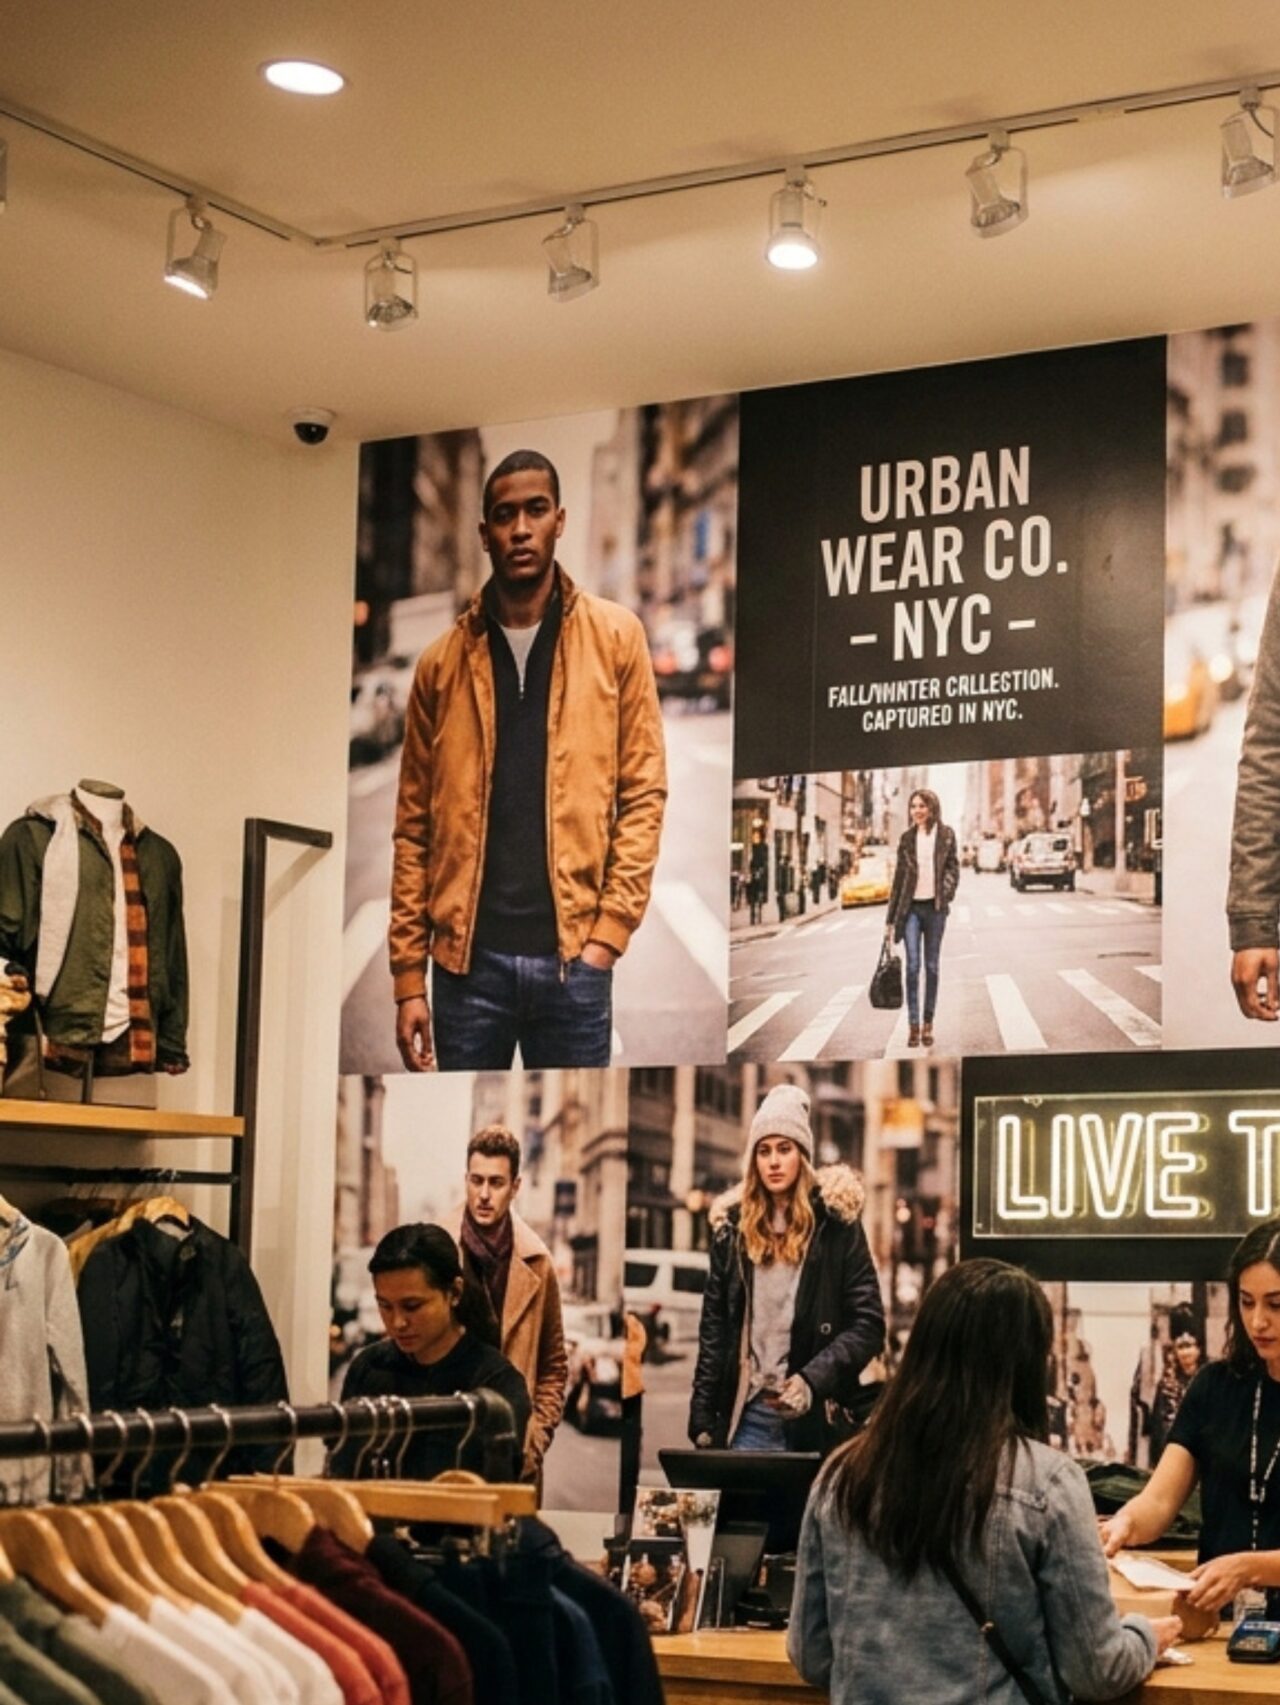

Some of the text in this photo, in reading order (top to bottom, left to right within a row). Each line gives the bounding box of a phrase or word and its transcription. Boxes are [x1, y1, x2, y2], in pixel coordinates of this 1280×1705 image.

[860, 445, 1030, 524] URBAN
[820, 514, 1069, 597] WEAR CO.
[893, 592, 992, 662] NYC
[862, 698, 1024, 733] CAPTURED IN NYC.
[996, 1112, 1200, 1220] LIVE
